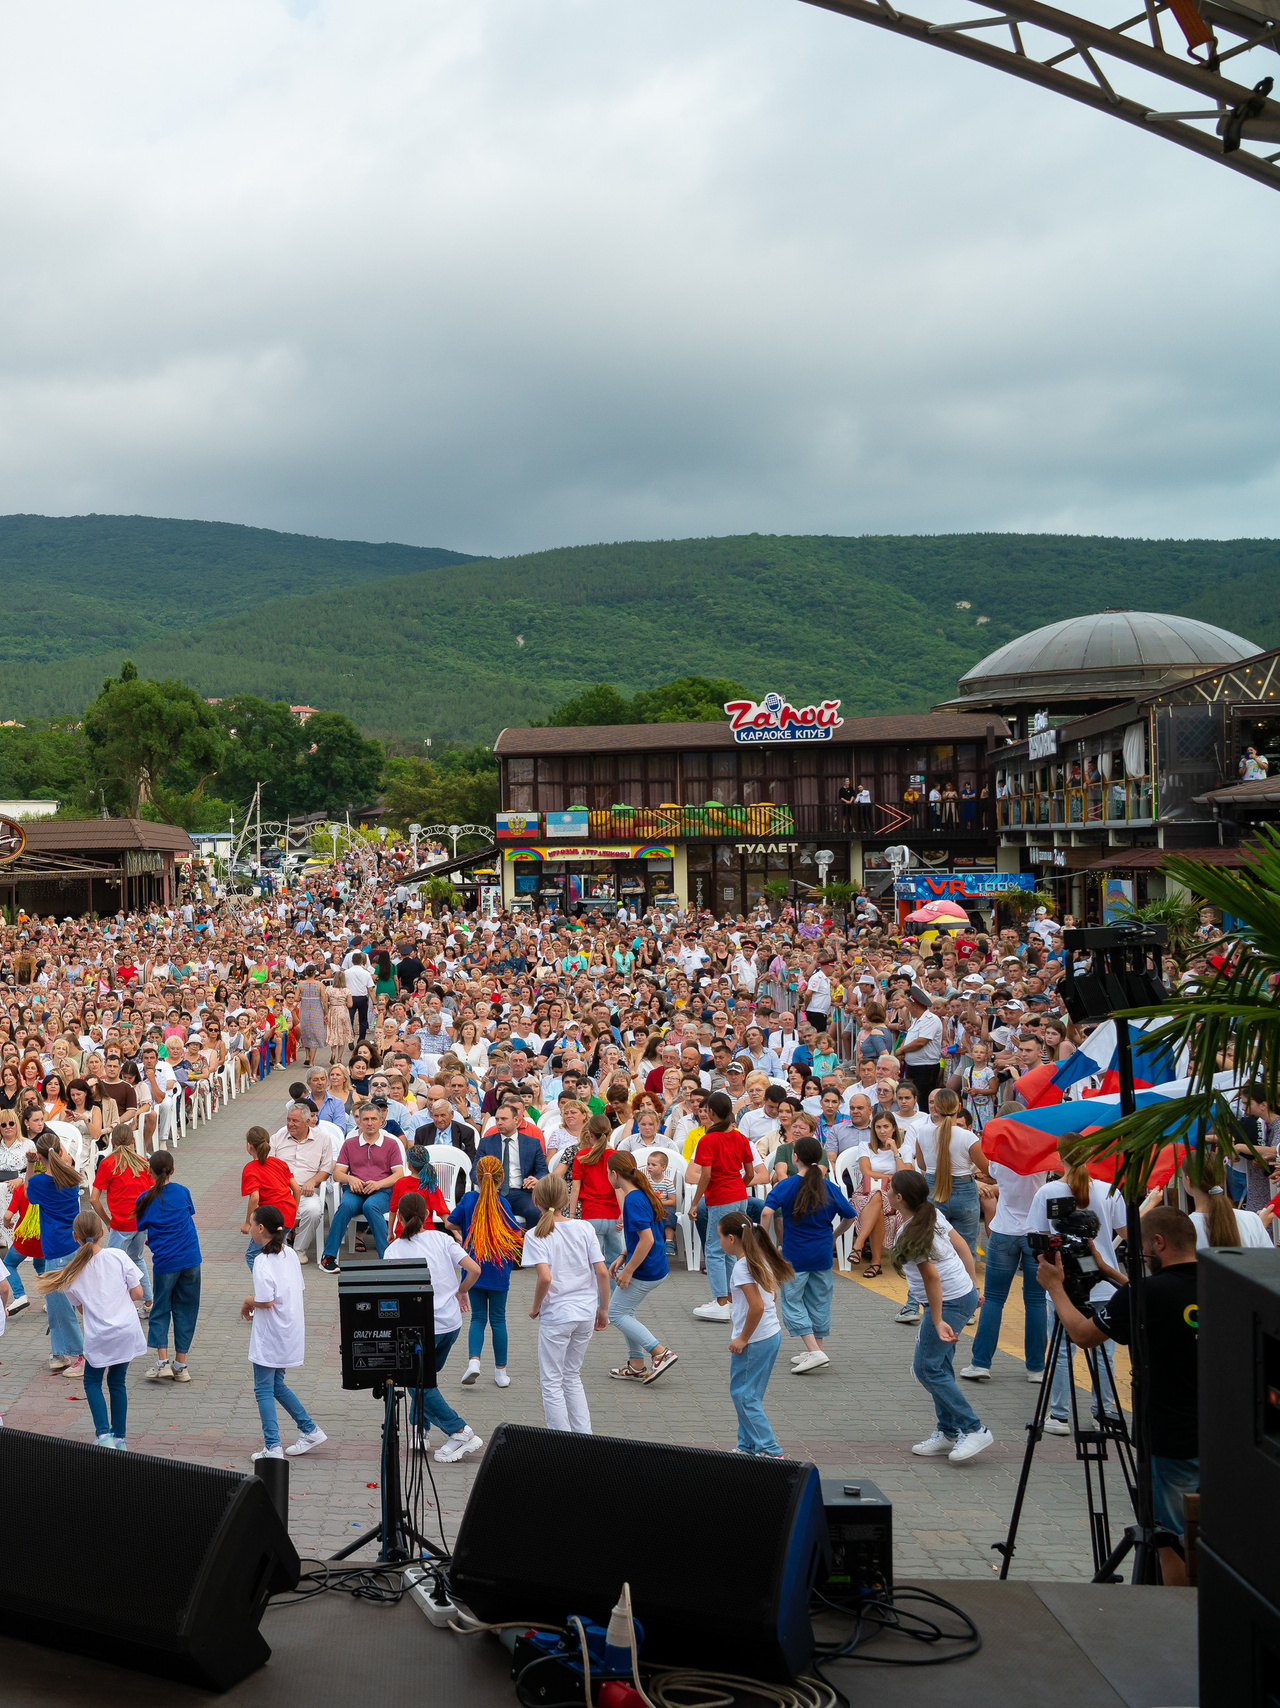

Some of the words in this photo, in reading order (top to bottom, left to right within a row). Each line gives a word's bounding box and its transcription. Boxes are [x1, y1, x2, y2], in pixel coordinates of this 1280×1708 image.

[740, 730, 792, 741] КАРАОКЕ
[795, 729, 826, 739] КЛУБ
[548, 848, 580, 857] ИГРОВЫЕ
[735, 843, 799, 854] ТУАЛЕТ
[924, 877, 968, 896] VR
[353, 1330, 373, 1338] CRAZY
[372, 1330, 392, 1338] FLAME
